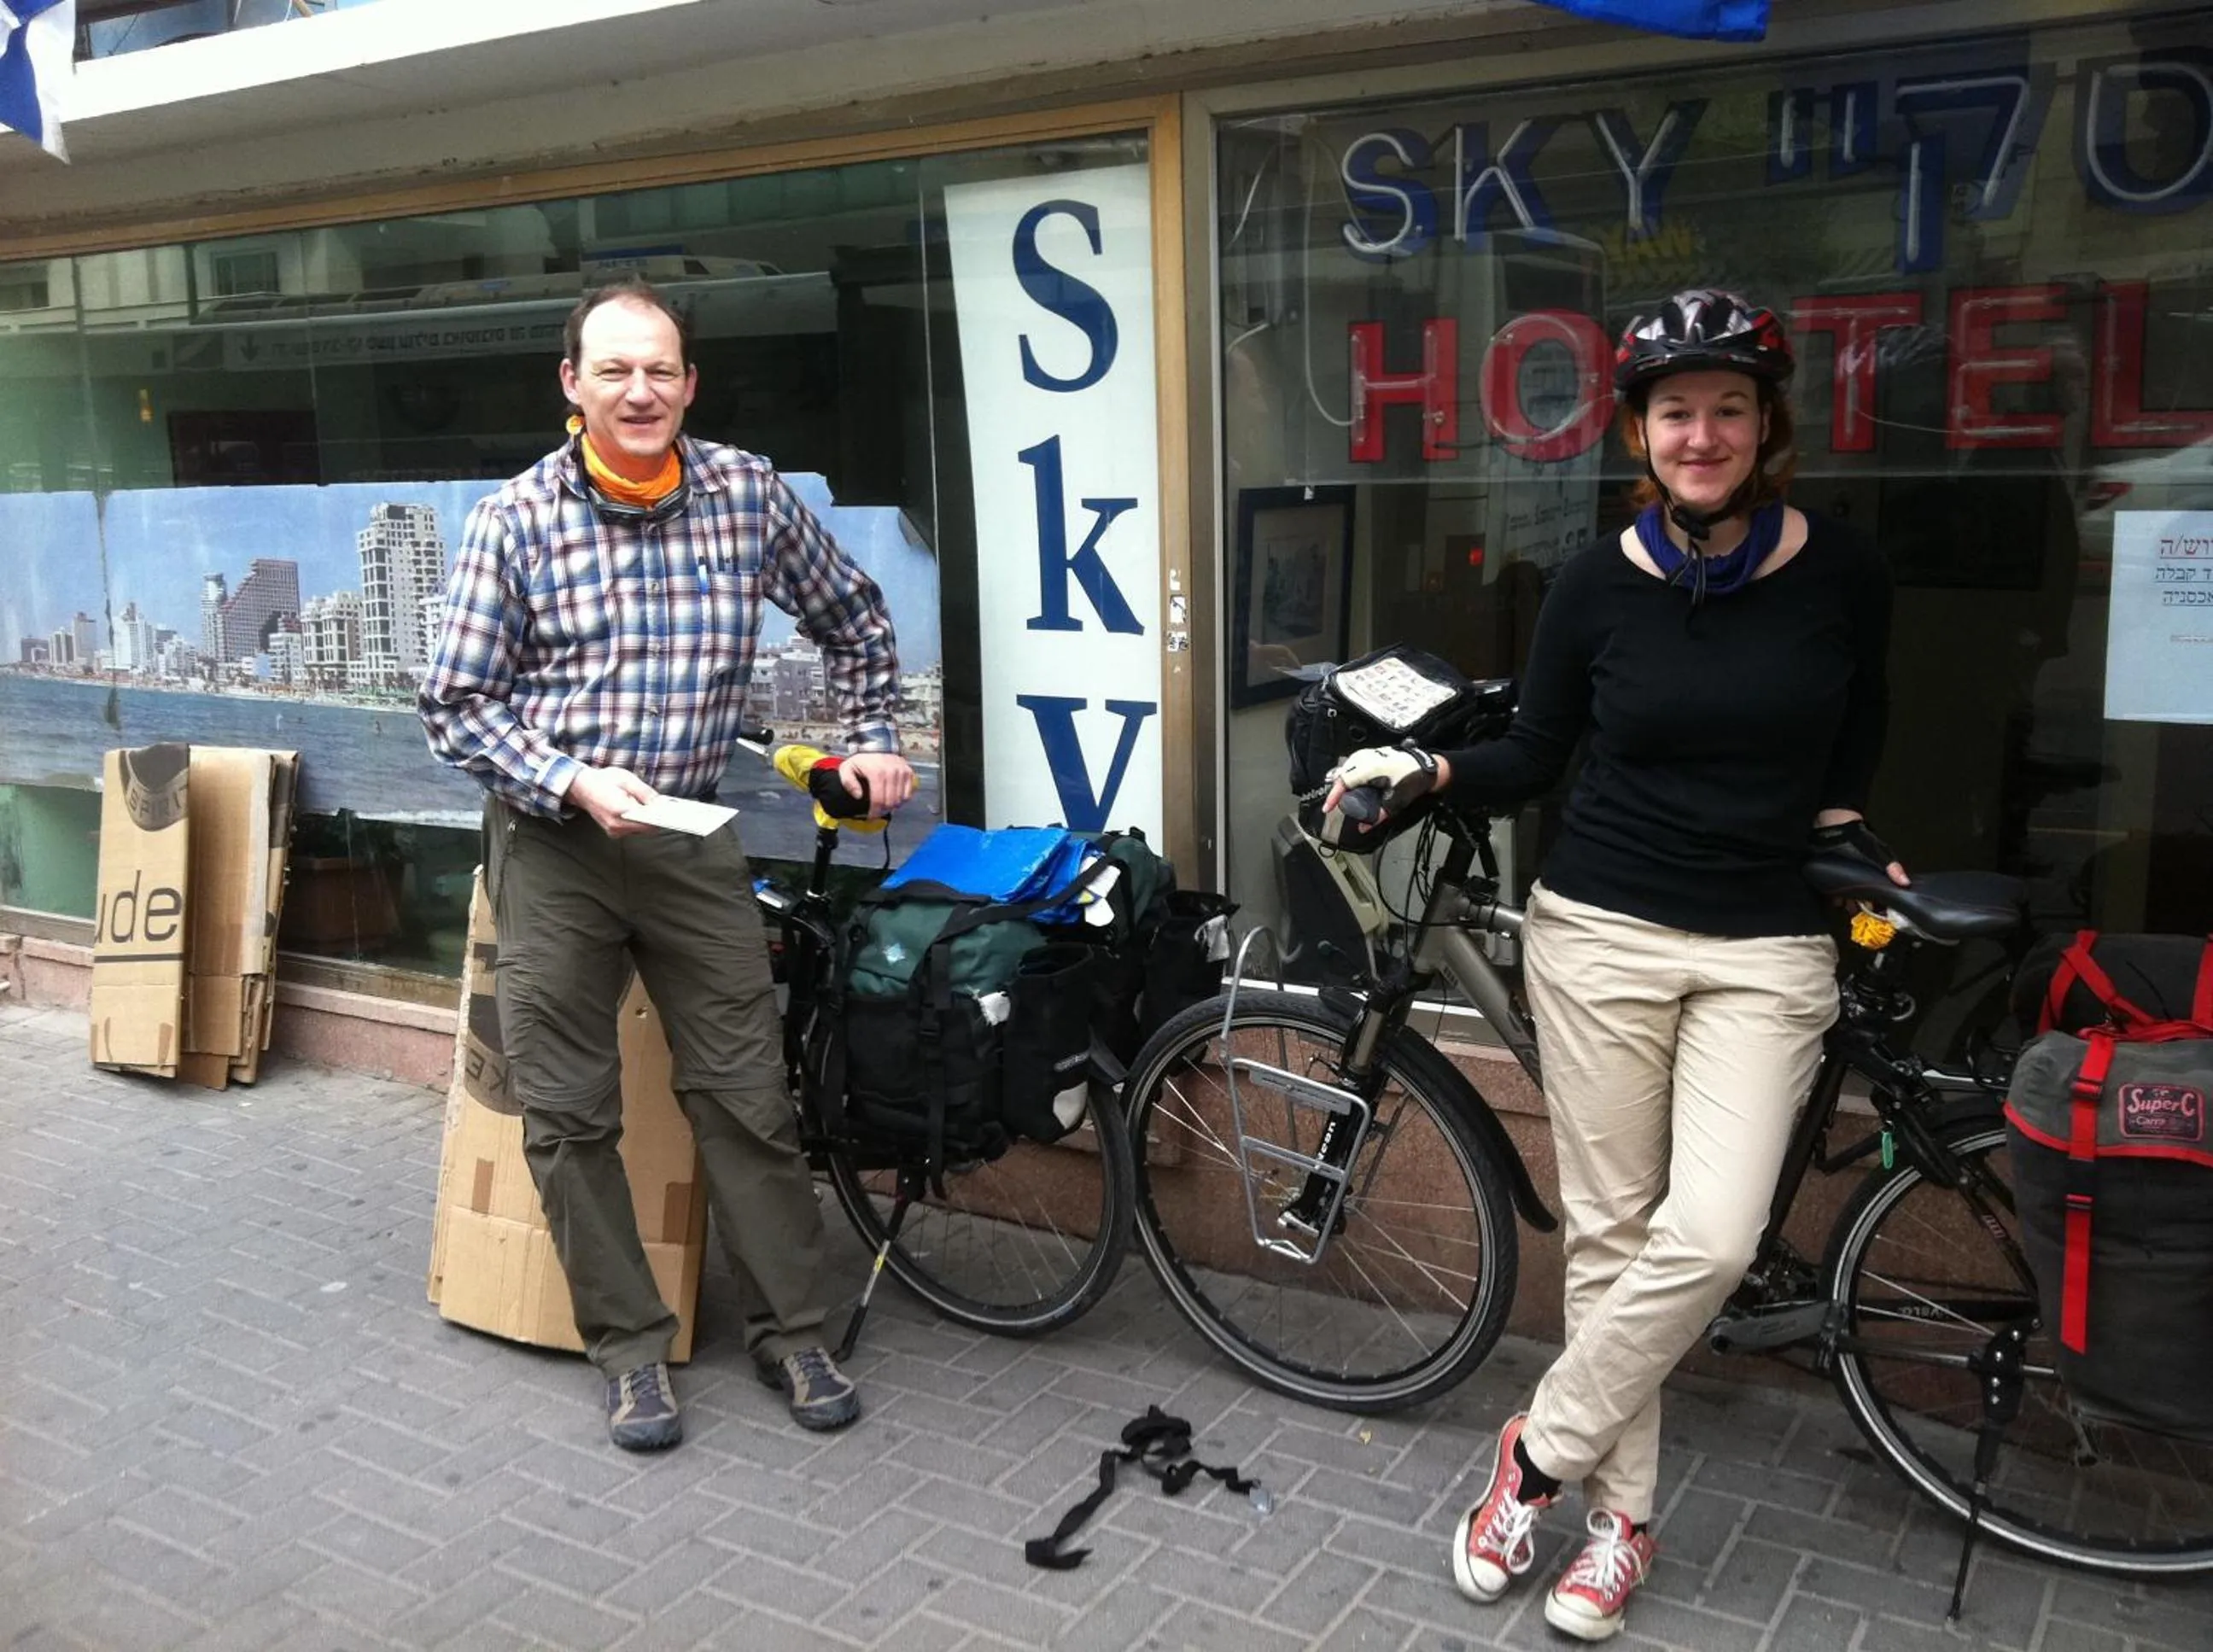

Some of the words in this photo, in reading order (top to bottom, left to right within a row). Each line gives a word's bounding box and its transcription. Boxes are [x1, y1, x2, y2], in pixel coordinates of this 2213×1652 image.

[1341, 98, 1711, 264] SKY
[1347, 278, 2213, 463] HOTEL
[2160, 532, 2213, 555] וש/ה
[2155, 566, 2196, 581] קבלת
[130, 784, 188, 818] SPIRI
